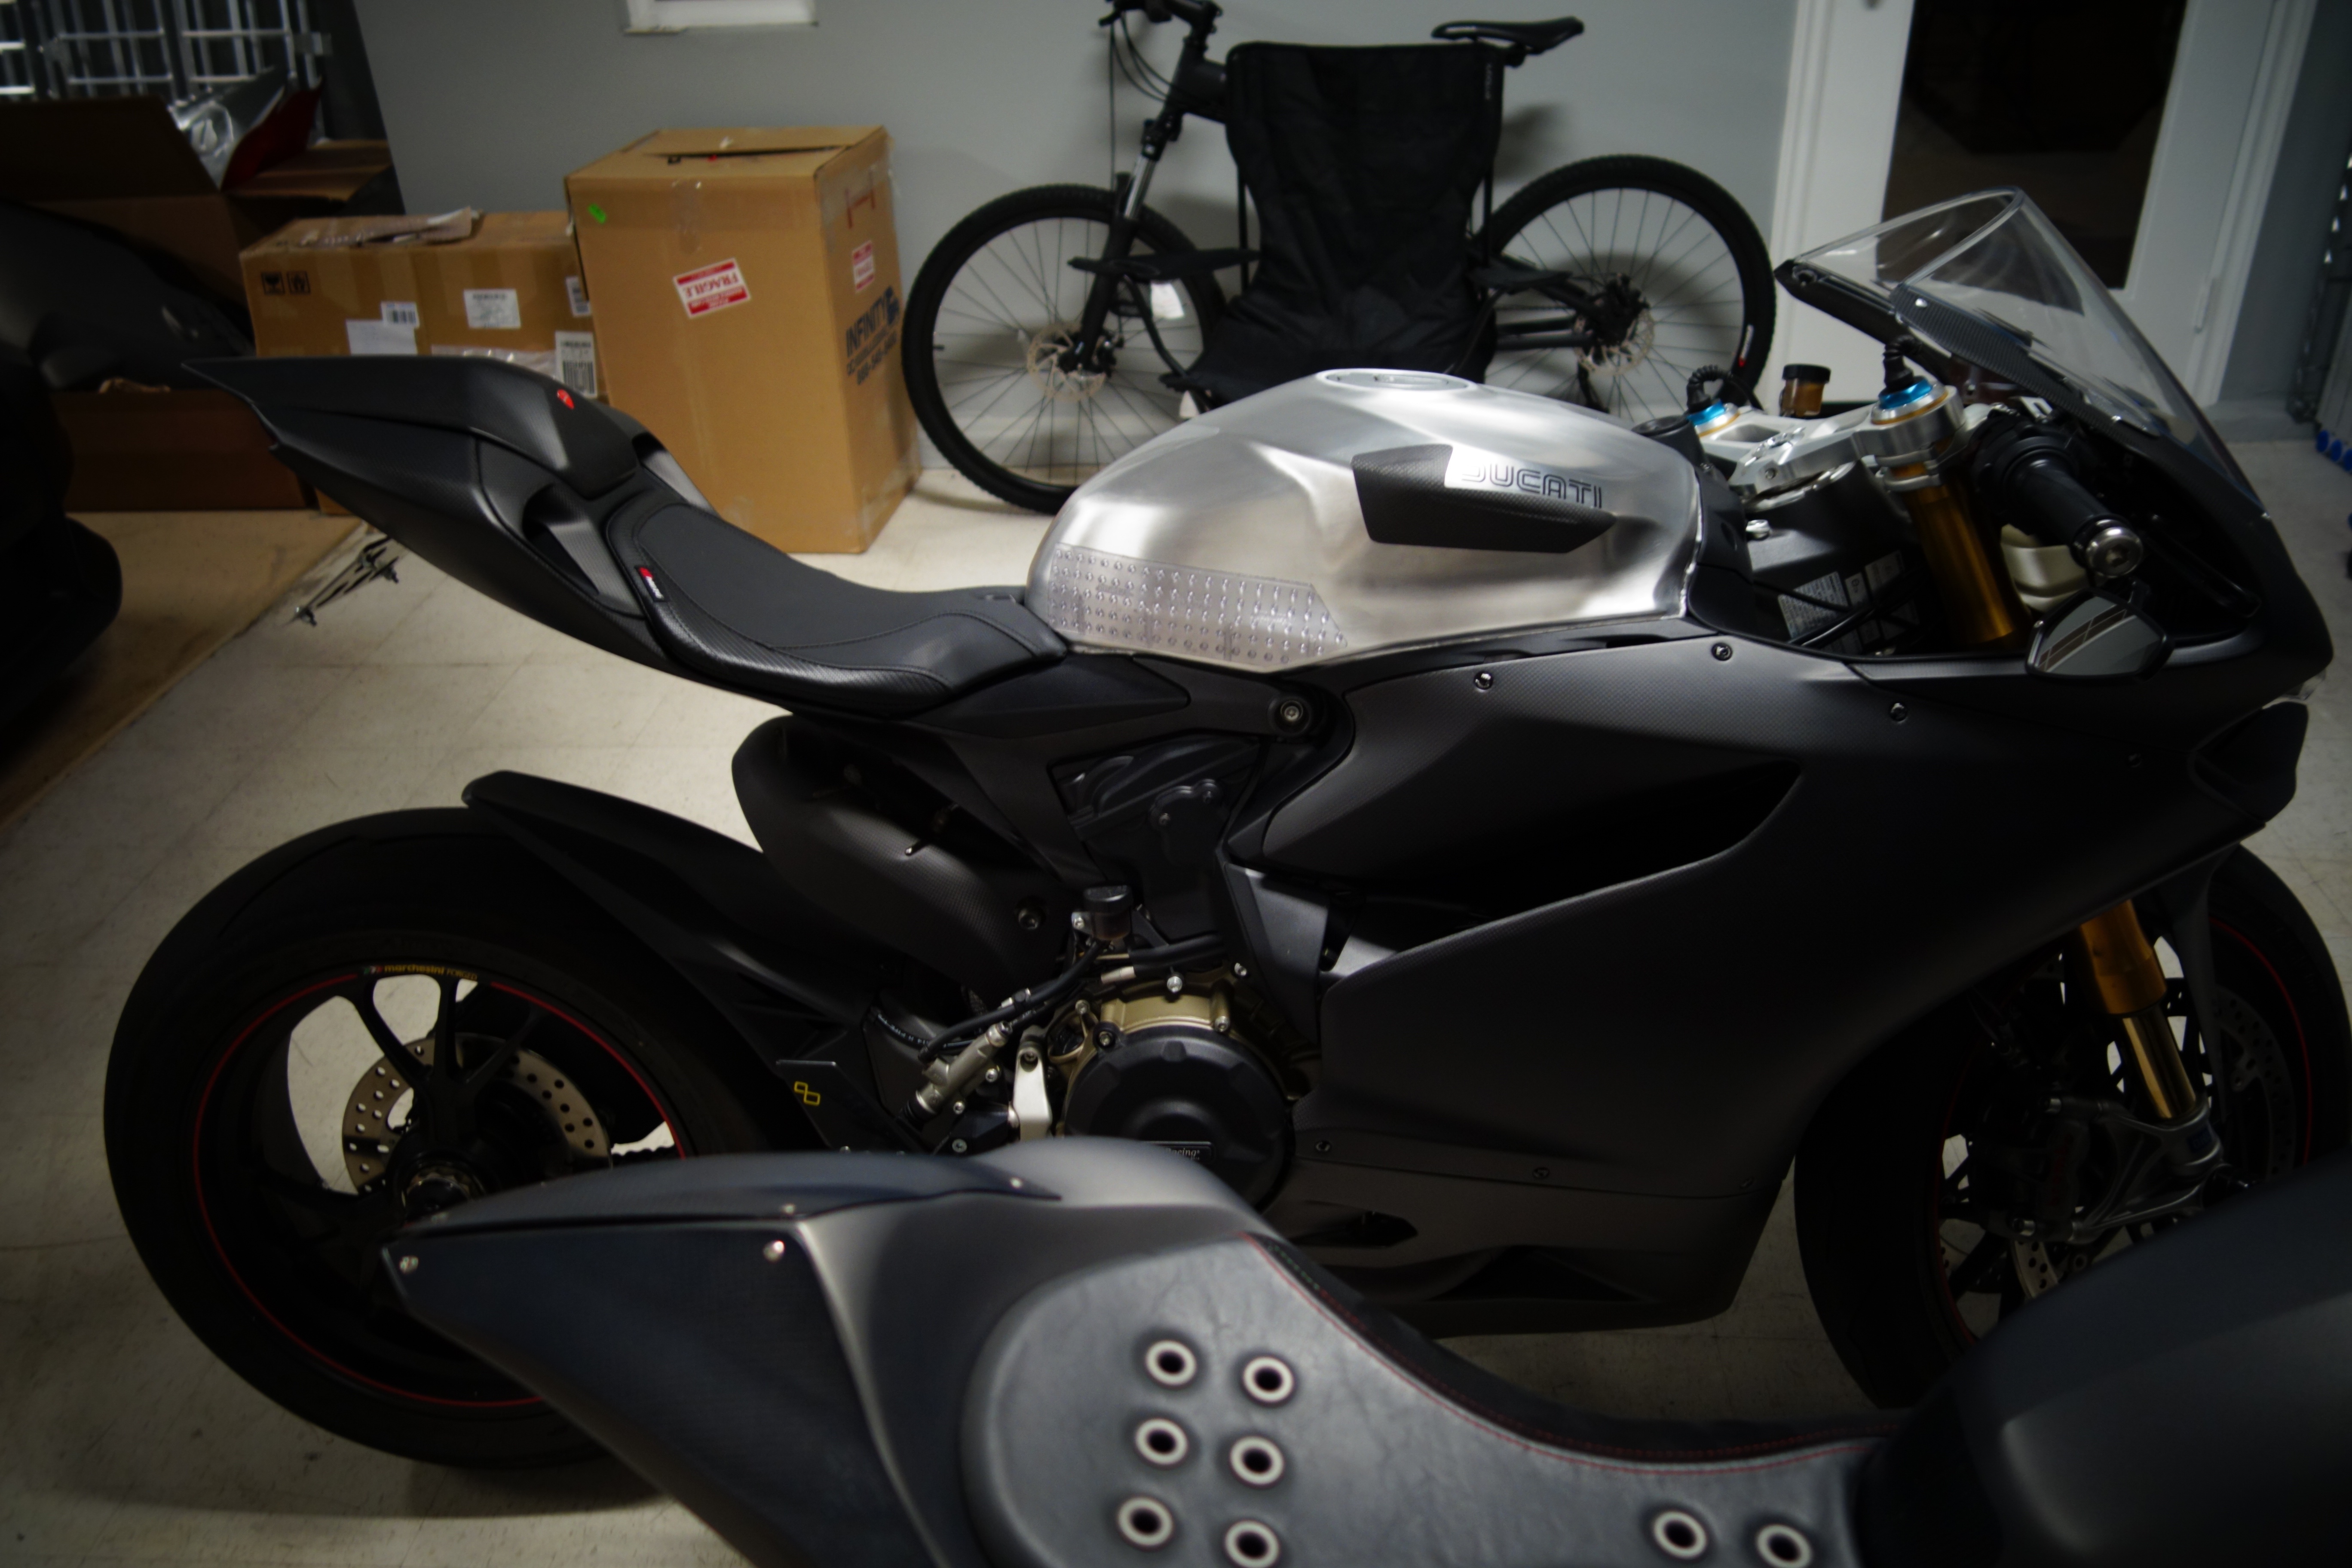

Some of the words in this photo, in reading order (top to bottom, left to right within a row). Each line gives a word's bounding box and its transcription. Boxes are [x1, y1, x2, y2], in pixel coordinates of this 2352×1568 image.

[683, 272, 738, 297] FRAGILE
[1461, 463, 1602, 509] DUCATI
[383, 964, 445, 975] marchesini
